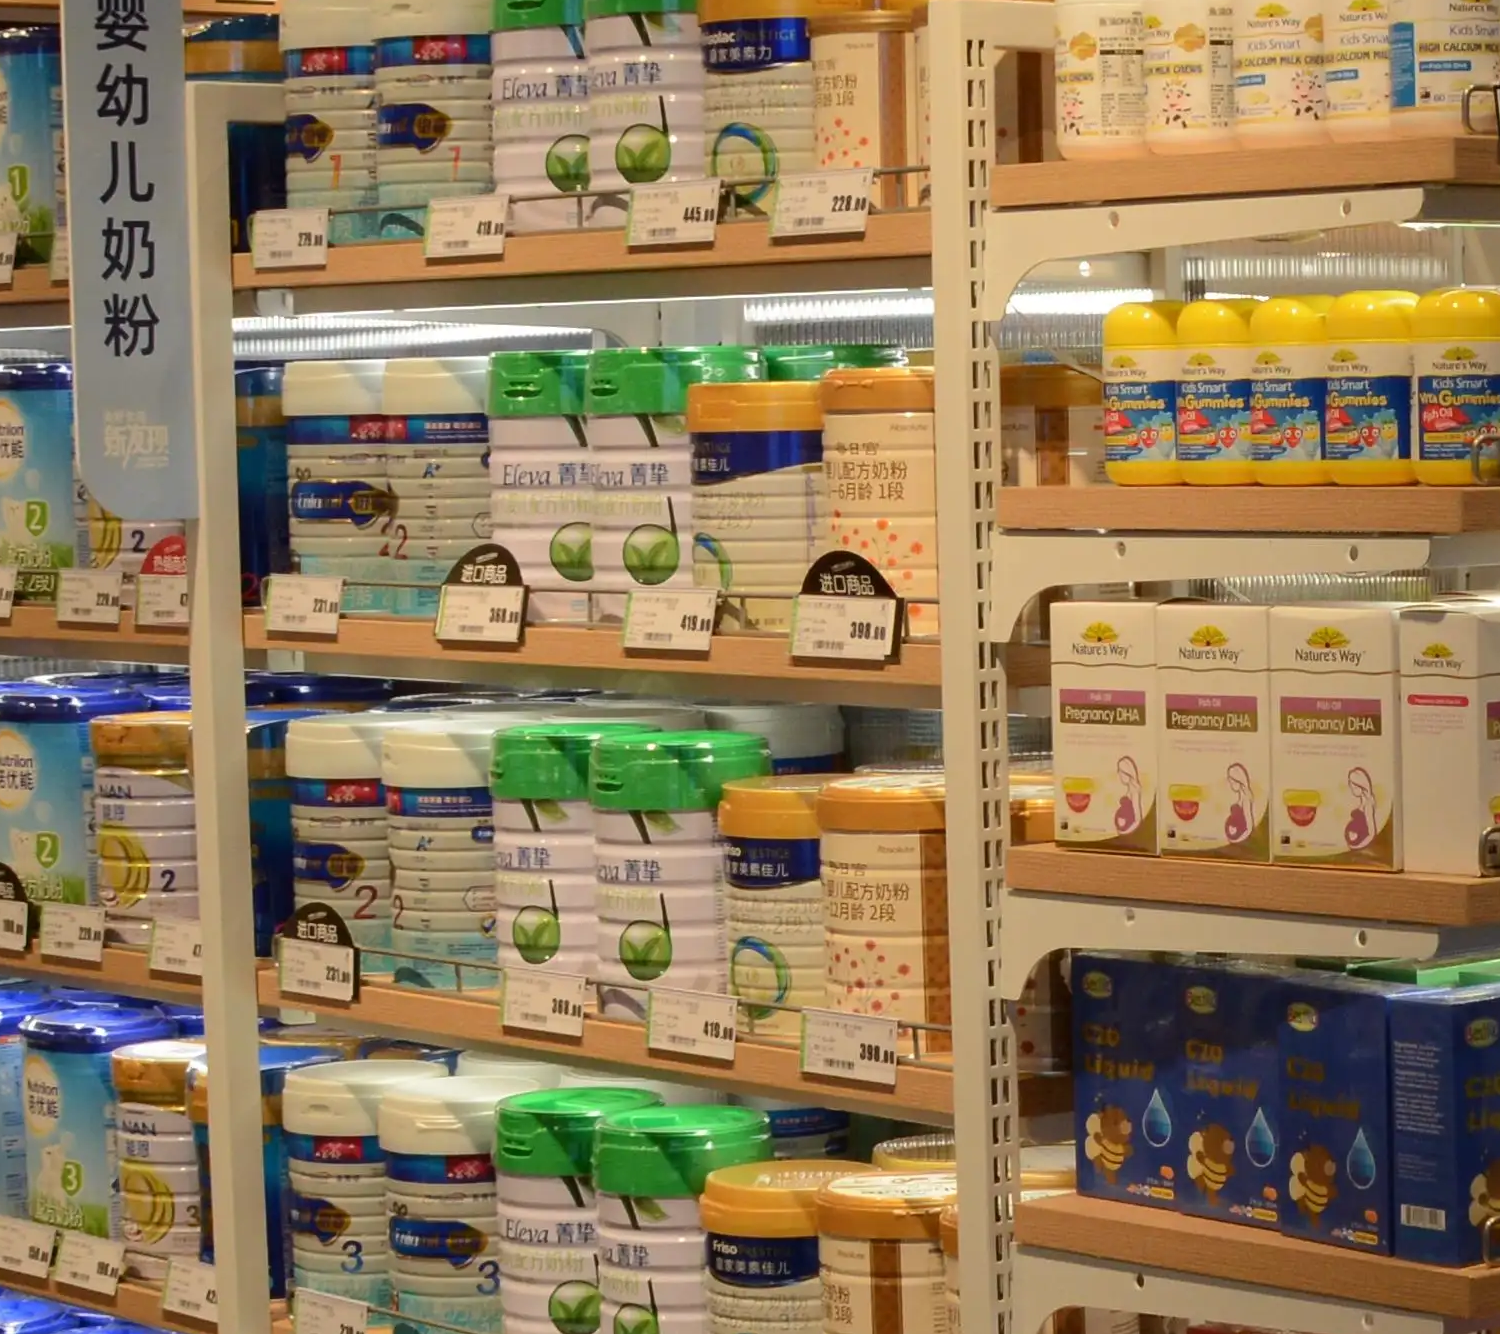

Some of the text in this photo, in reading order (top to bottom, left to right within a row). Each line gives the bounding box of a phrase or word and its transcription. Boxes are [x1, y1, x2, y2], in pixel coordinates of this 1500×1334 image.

[1449, 24, 1473, 37] Kids
[1247, 37, 1301, 51] Kids Smart
[1443, 41, 1478, 53] CALCIUM
[502, 73, 548, 101] Eleva
[1432, 378, 1488, 389] Kids Smart
[502, 464, 551, 487] Eleva
[461, 564, 508, 585] 进口商品
[819, 573, 875, 596] 进口商品
[1072, 642, 1130, 659] Nature's Way
[1178, 647, 1240, 664] Nature's Way
[1295, 648, 1362, 666] Nature's Way
[1065, 706, 1139, 724] Pregnancy DHA
[1172, 712, 1251, 729] Pregnancy DHA
[1287, 715, 1375, 733] Pregnancy DHA
[353, 884, 377, 920] 2
[506, 1219, 549, 1244] Eleva
[711, 1239, 738, 1255] Friso
[341, 1240, 364, 1274] 3
